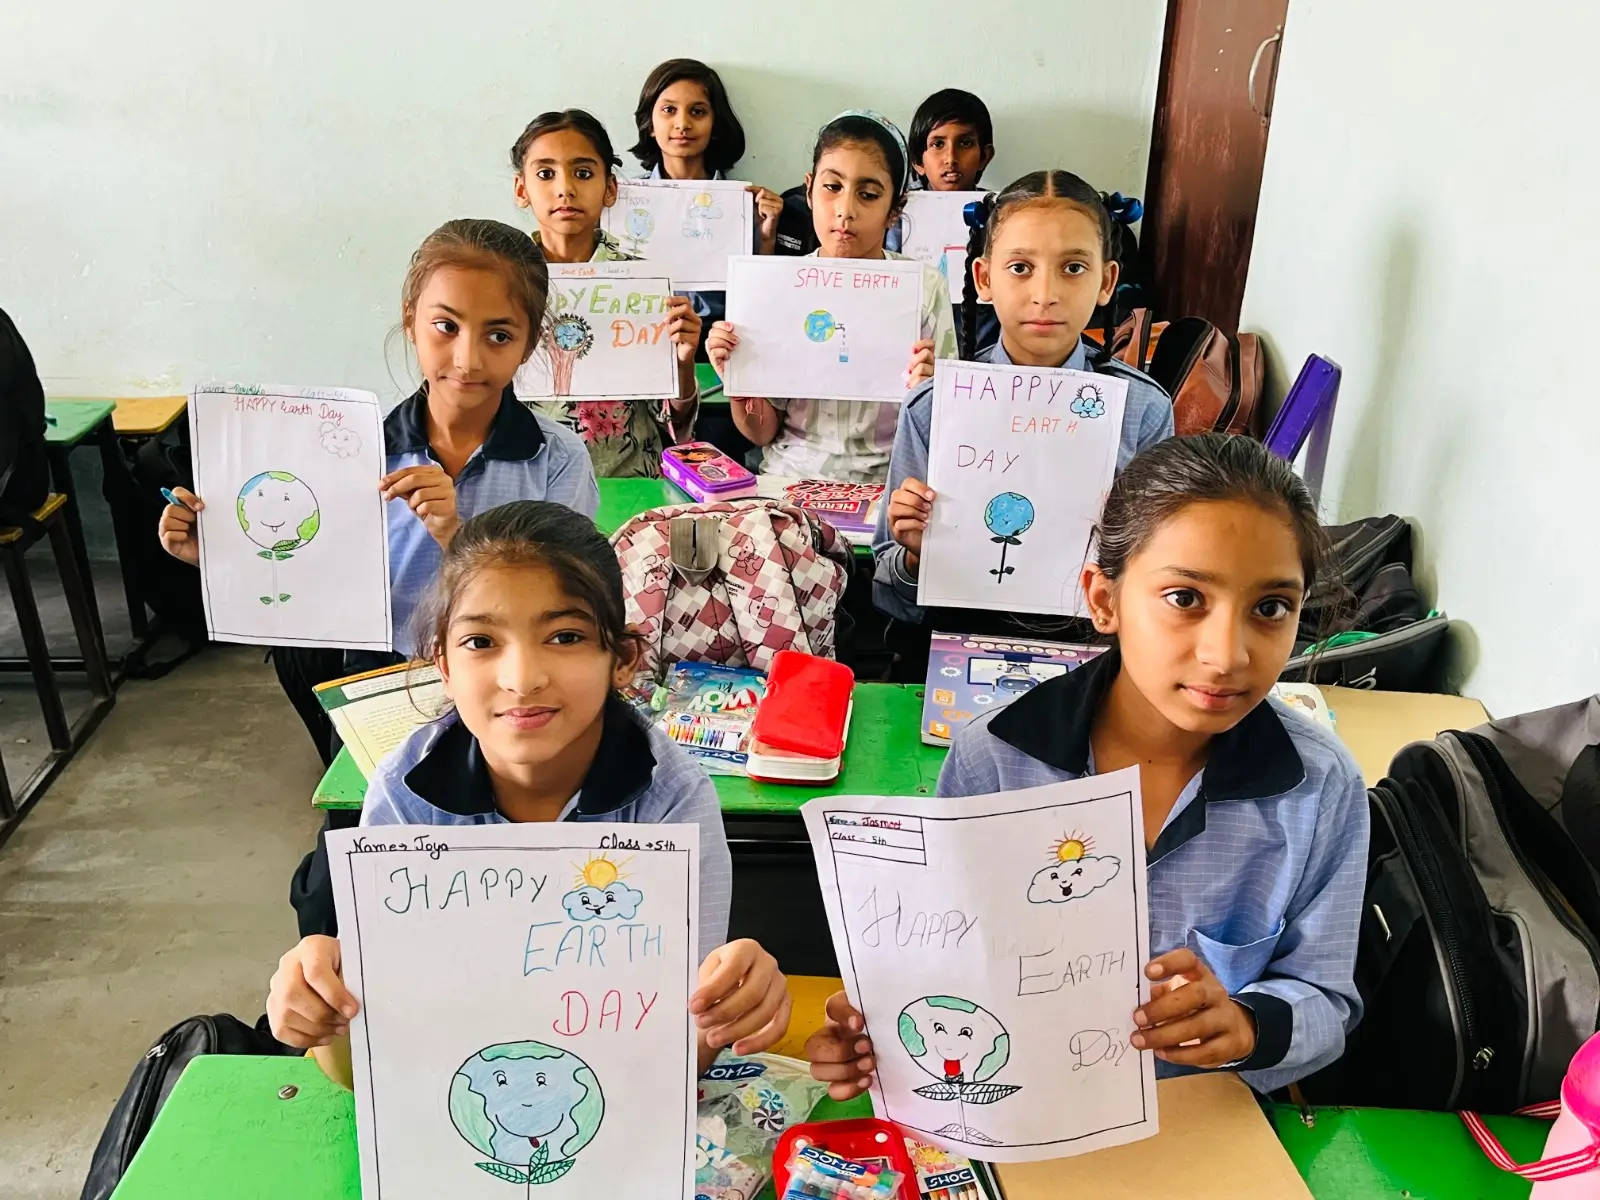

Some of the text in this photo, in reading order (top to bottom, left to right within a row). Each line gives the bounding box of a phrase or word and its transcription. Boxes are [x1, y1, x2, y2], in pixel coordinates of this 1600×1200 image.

[794, 267, 899, 289] SAVE EARTH
[611, 319, 668, 348] DAY
[954, 371, 1063, 405] HAPPY
[234, 396, 277, 413] HAPPY
[319, 403, 345, 427] Day
[1011, 415, 1078, 435] EARTH
[957, 444, 1020, 474] DAY
[352, 836, 398, 853] Name
[599, 832, 676, 852] Class 5th
[384, 866, 547, 914] HAPPY
[523, 921, 662, 977] EARTH
[1017, 947, 1126, 997] EARTH
[552, 989, 659, 1037] DAY
[804, 1148, 865, 1173] DOMS
[929, 1170, 972, 1188] DOMS
